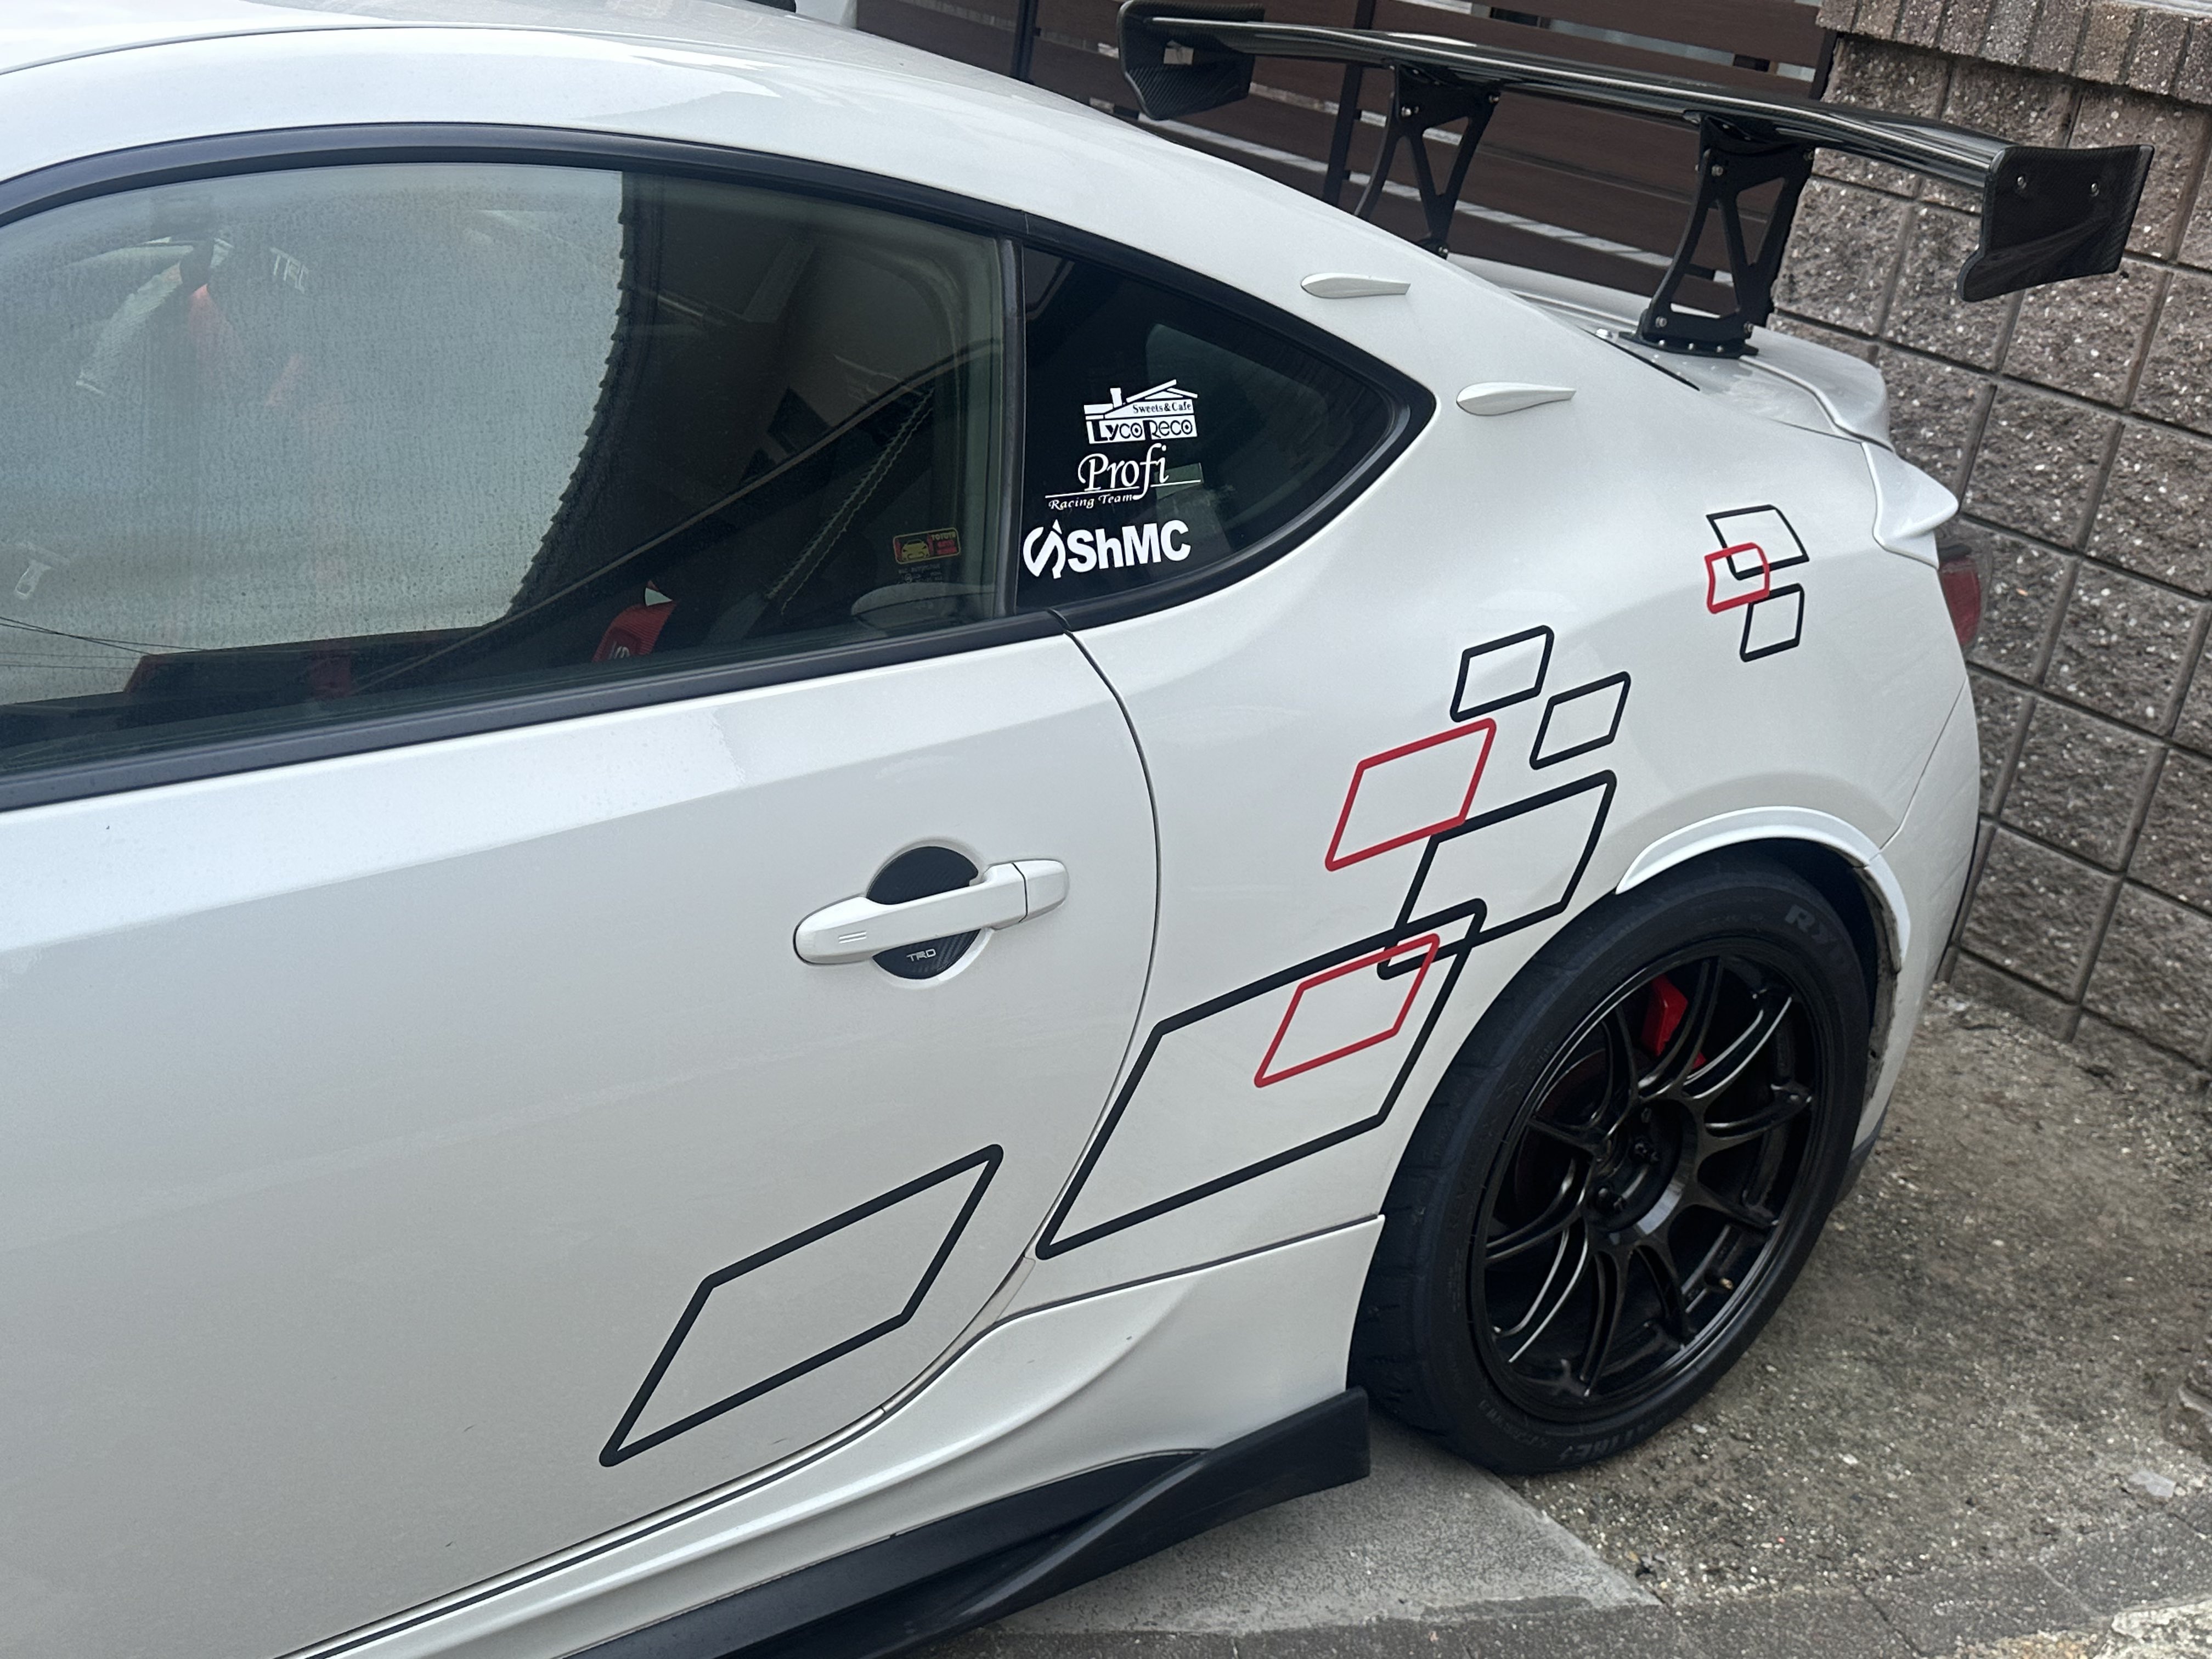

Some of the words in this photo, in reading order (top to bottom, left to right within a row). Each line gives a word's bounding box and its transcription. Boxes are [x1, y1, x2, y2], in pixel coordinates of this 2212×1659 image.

[1077, 442, 1169, 500] Profi
[1048, 496, 1094, 510] Racing
[1098, 493, 1133, 505] Team
[1066, 519, 1192, 573] ShMC
[906, 947, 936, 962] TRD
